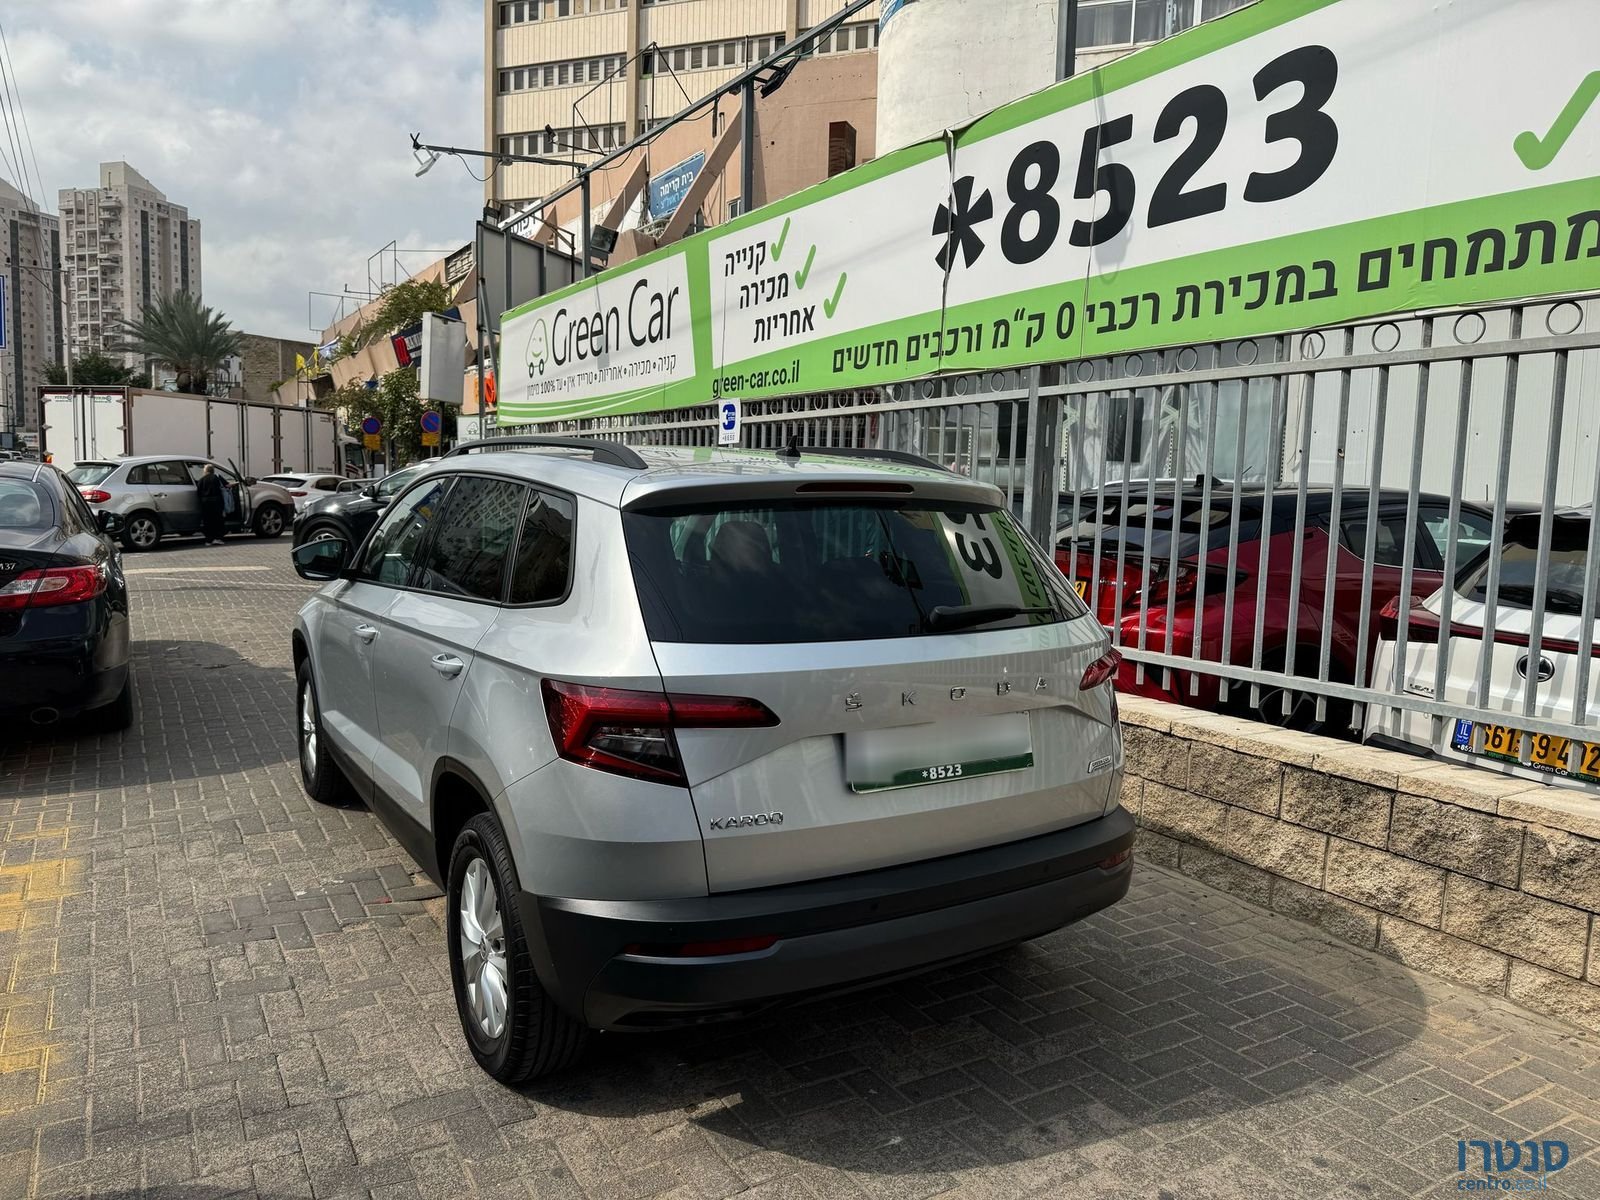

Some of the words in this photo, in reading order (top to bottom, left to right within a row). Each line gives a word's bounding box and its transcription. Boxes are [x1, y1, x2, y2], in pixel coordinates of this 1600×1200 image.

[681, 171, 694, 186] בית
[725, 240, 766, 277] קנייה
[740, 272, 789, 309] מכירה
[1172, 259, 1339, 322] במכירת
[552, 306, 619, 366] Green
[628, 278, 679, 347] Car
[754, 305, 815, 343] אחריות
[1085, 292, 1161, 335] רכבי
[832, 339, 899, 374] חדשים
[906, 323, 983, 363] ורכבים
[598, 365, 623, 383] אחריות
[628, 359, 651, 378] מכירה
[657, 354, 677, 375] קניה
[712, 359, 800, 398] green-car.co.il
[540, 379, 556, 394] 100%
[1460, 723, 1469, 736] IL
[1532, 761, 1554, 774] Green
[1555, 767, 1569, 776] Car
[710, 811, 784, 831] KAROQ
